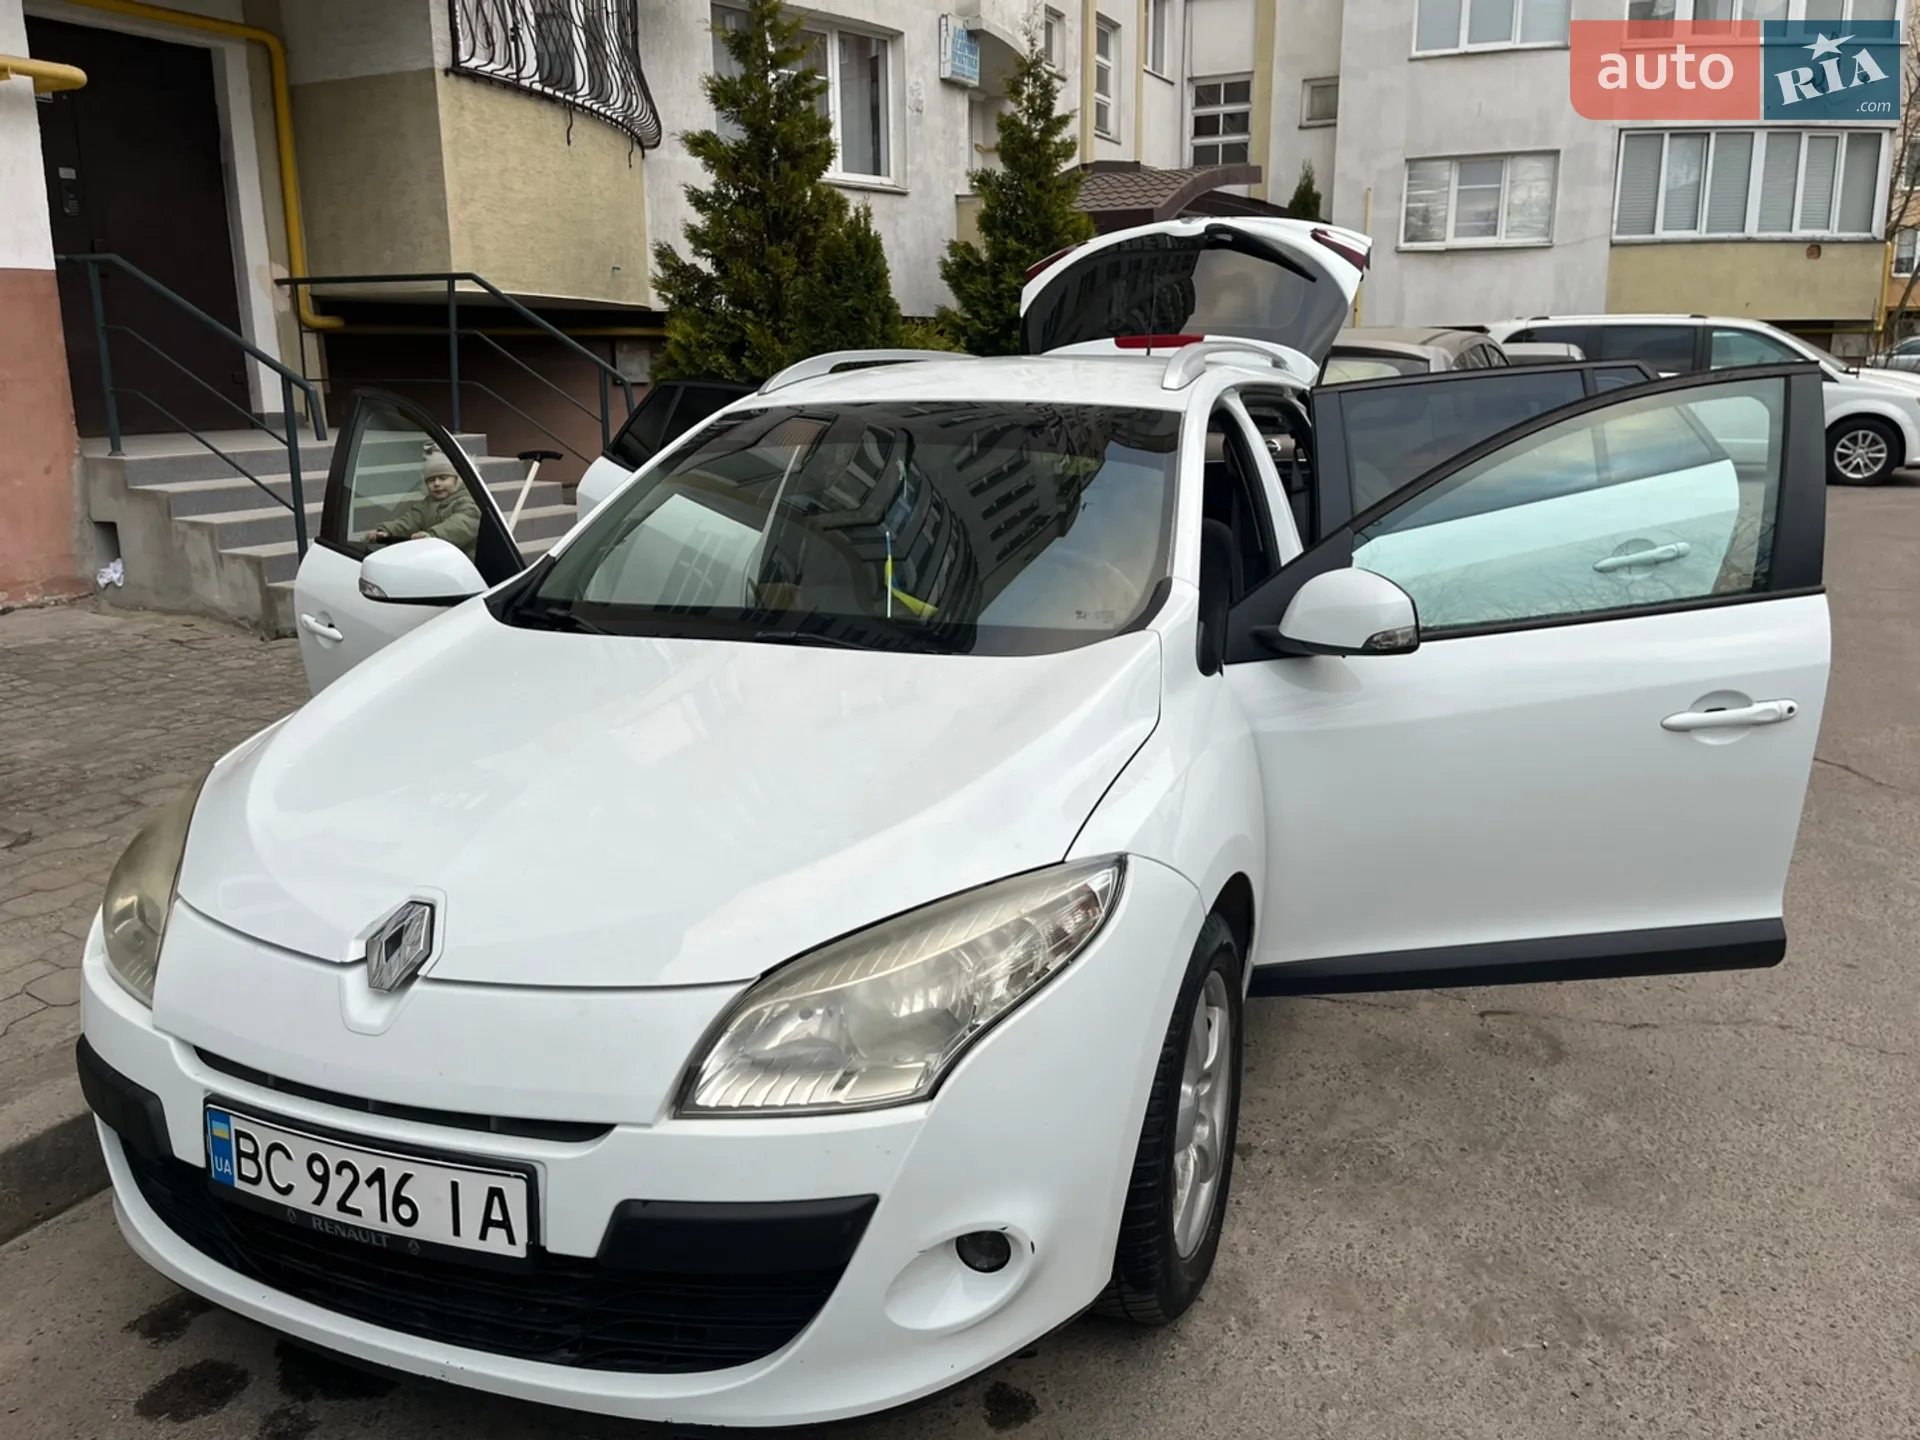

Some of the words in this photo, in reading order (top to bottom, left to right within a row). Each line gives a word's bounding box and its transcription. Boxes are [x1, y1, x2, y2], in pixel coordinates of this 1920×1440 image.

[214, 1155, 233, 1176] UA
[234, 1127, 295, 1197] BC
[306, 1152, 420, 1228] 9216
[449, 1179, 518, 1247] IA
[311, 1215, 389, 1248] RENAULT
